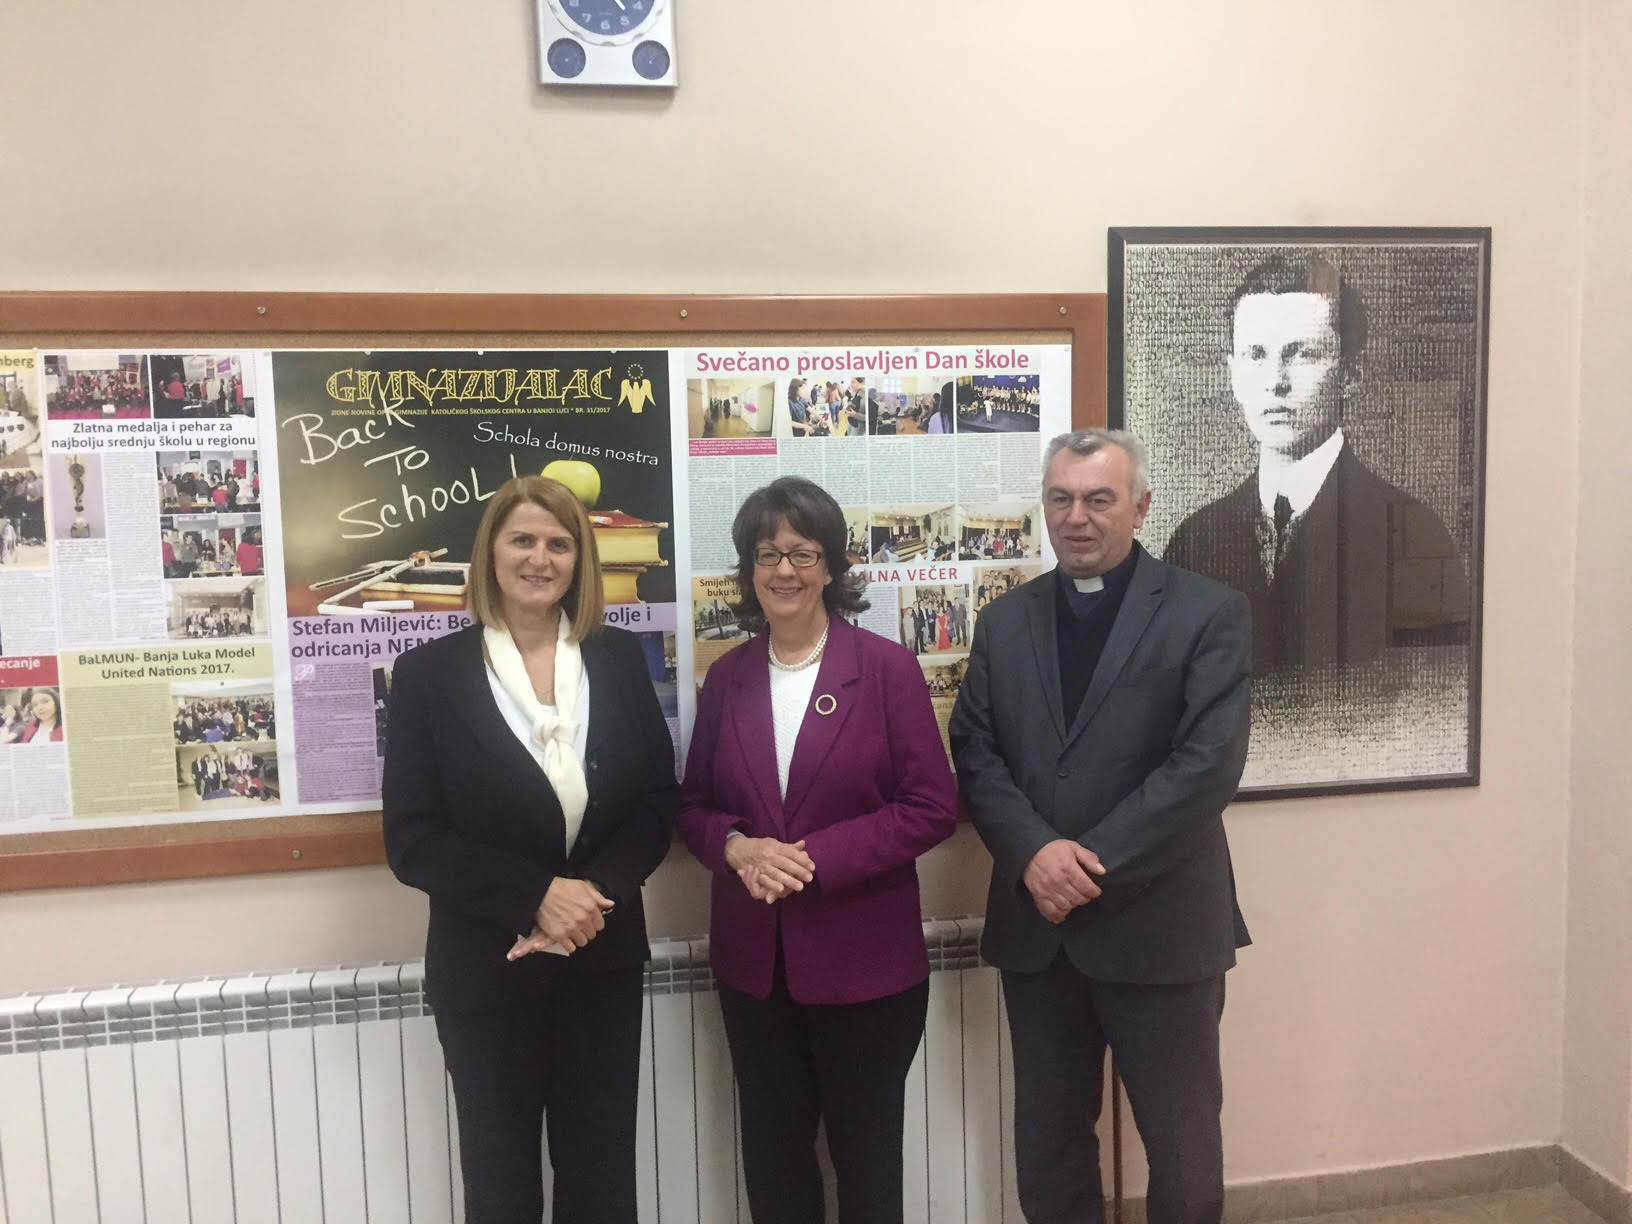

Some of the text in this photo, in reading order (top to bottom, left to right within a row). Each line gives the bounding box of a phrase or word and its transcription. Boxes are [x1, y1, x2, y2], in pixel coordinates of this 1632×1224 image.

[582, 13, 592, 23] 7
[601, 20, 611, 30] 6
[696, 348, 1029, 375] Svečano proslavljen Dan škole
[73, 421, 233, 435] Zlatna medalja i pehar za
[51, 435, 256, 450] najbolju srednju školu u regionu
[473, 420, 660, 467] Schola domus nostra
[907, 565, 958, 581] VEČER
[707, 588, 729, 597] buku
[292, 619, 354, 636] Stefan
[360, 614, 441, 636] Miljević:
[447, 614, 471, 630] Be
[646, 606, 651, 622] i
[143, 651, 179, 663] Banja
[182, 650, 211, 661] Luka
[215, 647, 256, 659] Model
[291, 639, 381, 659] odricanja
[101, 663, 235, 679] United Nations 2017.
